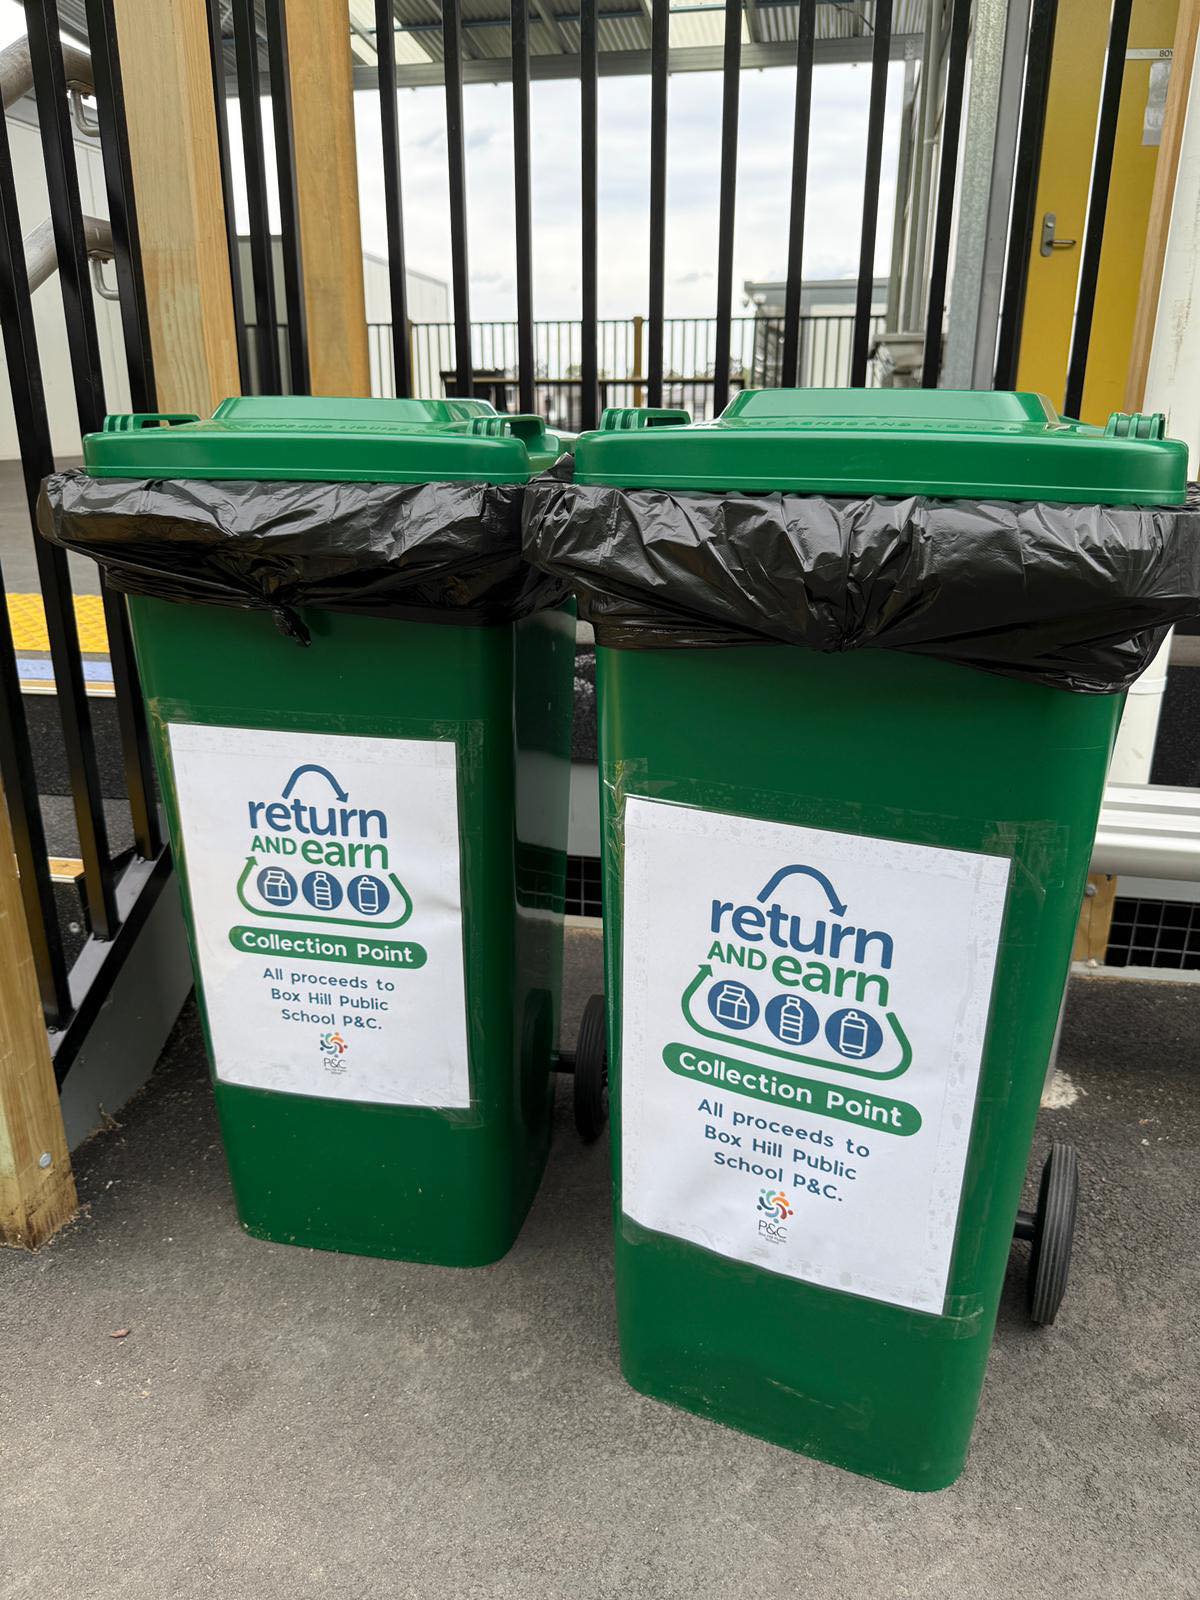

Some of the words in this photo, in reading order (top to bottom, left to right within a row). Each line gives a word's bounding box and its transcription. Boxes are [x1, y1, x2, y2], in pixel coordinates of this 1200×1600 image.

[248, 798, 388, 839] return
[251, 835, 297, 856] AND
[300, 839, 389, 870] earn
[242, 931, 348, 957] Collection
[356, 943, 414, 963] Point
[710, 899, 894, 970] return
[263, 967, 284, 981] All
[290, 972, 369, 990] proceeds
[375, 978, 395, 992] to
[707, 940, 768, 971] AND
[771, 954, 890, 1008] earn
[271, 987, 301, 1002] Box
[308, 991, 332, 1006] Hill
[339, 995, 389, 1011] Public
[281, 1008, 336, 1026] School
[342, 1015, 382, 1030] P&C.
[323, 1057, 347, 1069] P&C
[679, 1051, 812, 1104] Collection
[826, 1090, 902, 1127] Point
[697, 1098, 723, 1119] All
[732, 1111, 834, 1148] proceeds
[845, 1138, 870, 1158] to
[704, 1124, 742, 1148] Box
[752, 1137, 783, 1159] Hill
[792, 1148, 857, 1181] Public
[713, 1151, 784, 1183] School
[792, 1172, 843, 1202] P&C.
[758, 1219, 788, 1239] P&C
